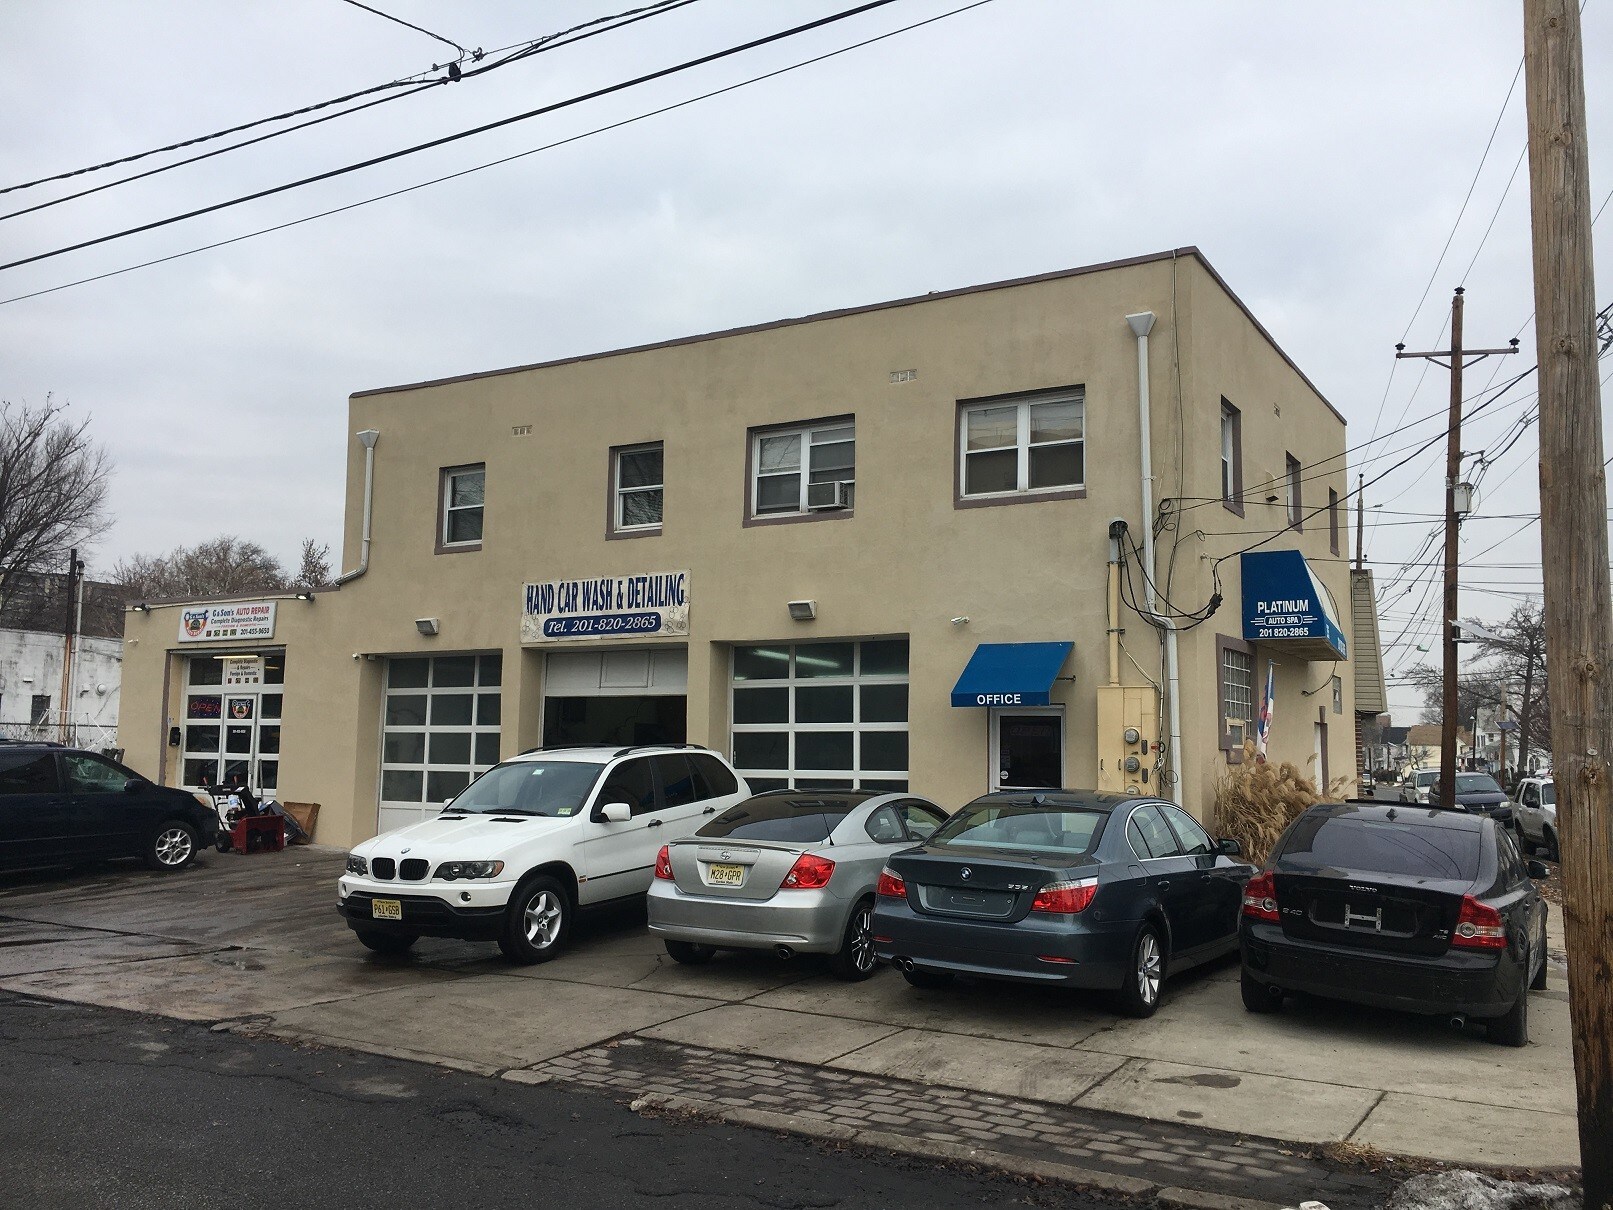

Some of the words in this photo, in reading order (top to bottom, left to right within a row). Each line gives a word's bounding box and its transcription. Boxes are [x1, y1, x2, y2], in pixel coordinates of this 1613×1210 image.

[526, 584, 554, 615] HAND
[557, 582, 578, 613] CAR
[582, 578, 613, 611] WASH
[616, 580, 624, 610] &
[627, 573, 685, 609] DETAILING
[236, 607, 250, 616] AUTO
[250, 606, 270, 615] REPAIR
[1257, 599, 1309, 614] PLATINUM
[210, 617, 230, 625] Complete
[231, 616, 253, 624] Diagnostic
[253, 615, 269, 623] Repairs
[548, 621, 567, 633] Tel.
[571, 615, 656, 632] 201-820-2865
[1268, 617, 1286, 625] AUTO
[1286, 616, 1299, 624] SPA
[1259, 628, 1273, 637] 201
[1273, 627, 1309, 637] 820-2865
[977, 693, 1021, 705] OFFICE
[190, 702, 221, 713] OPEN
